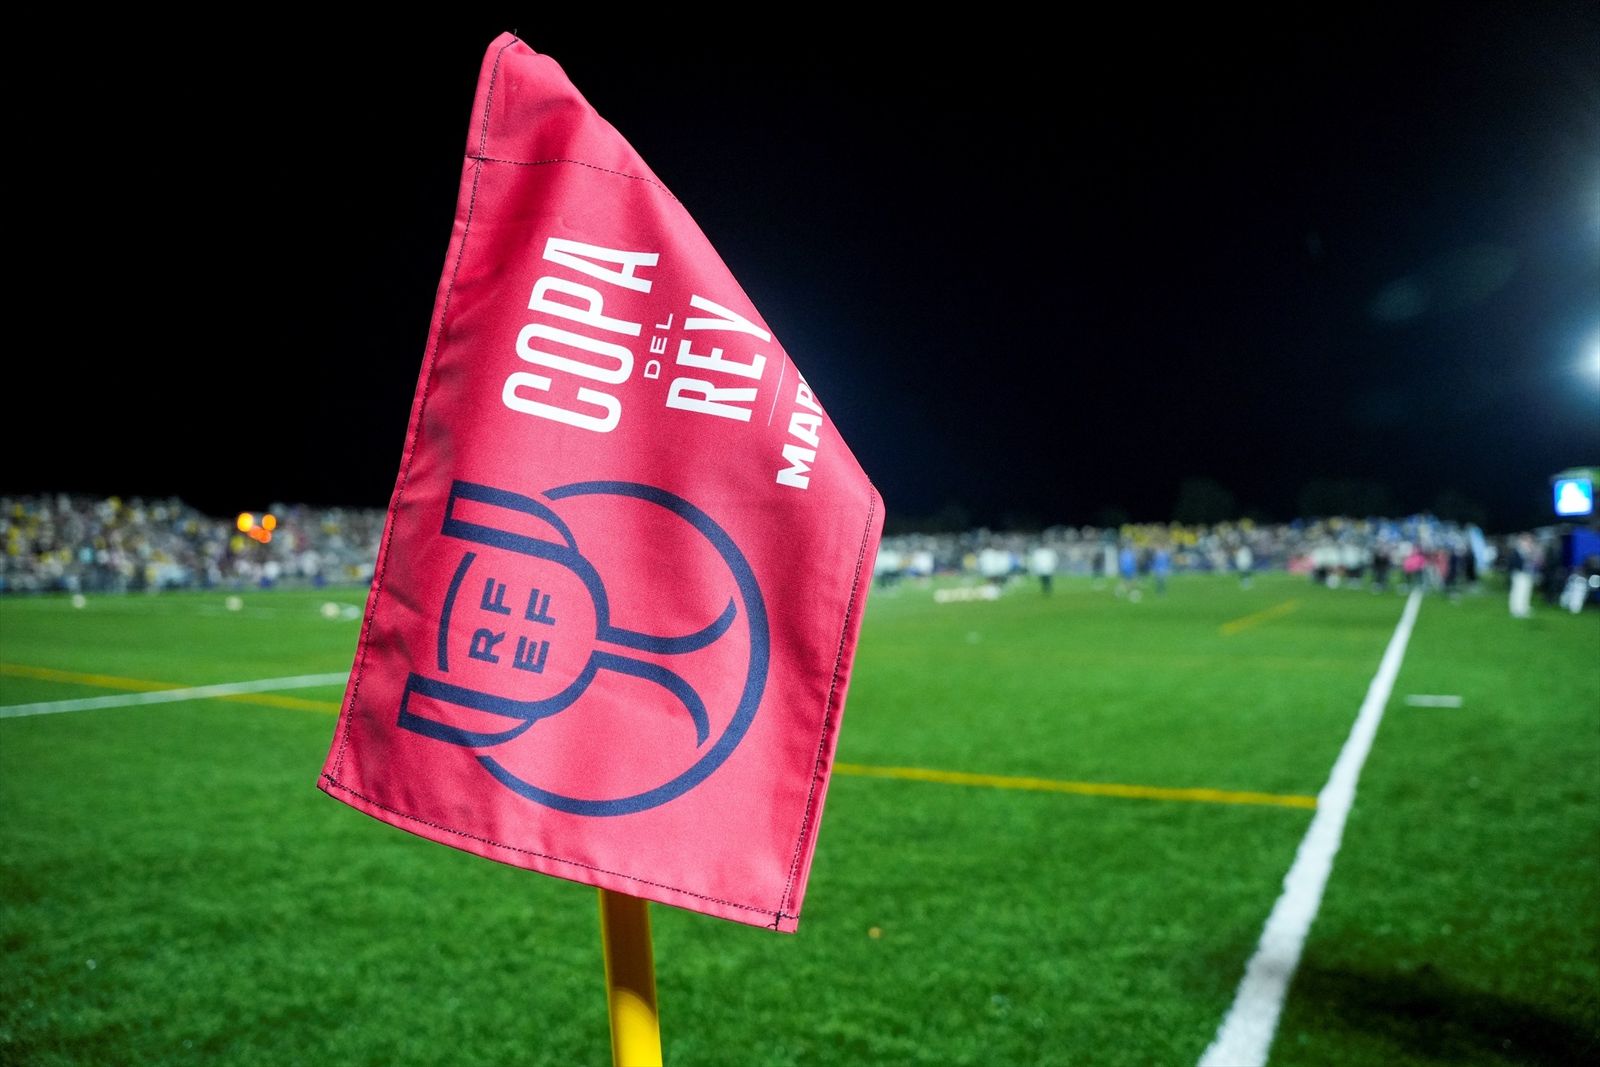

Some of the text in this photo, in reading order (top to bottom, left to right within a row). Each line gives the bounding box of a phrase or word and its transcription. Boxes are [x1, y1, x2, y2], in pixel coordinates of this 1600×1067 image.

[502, 237, 660, 433] COPA
[643, 313, 674, 380] DEL
[665, 294, 772, 422] REY
[776, 370, 823, 490] MAP
[467, 577, 512, 665] RF
[512, 587, 556, 675] EF
